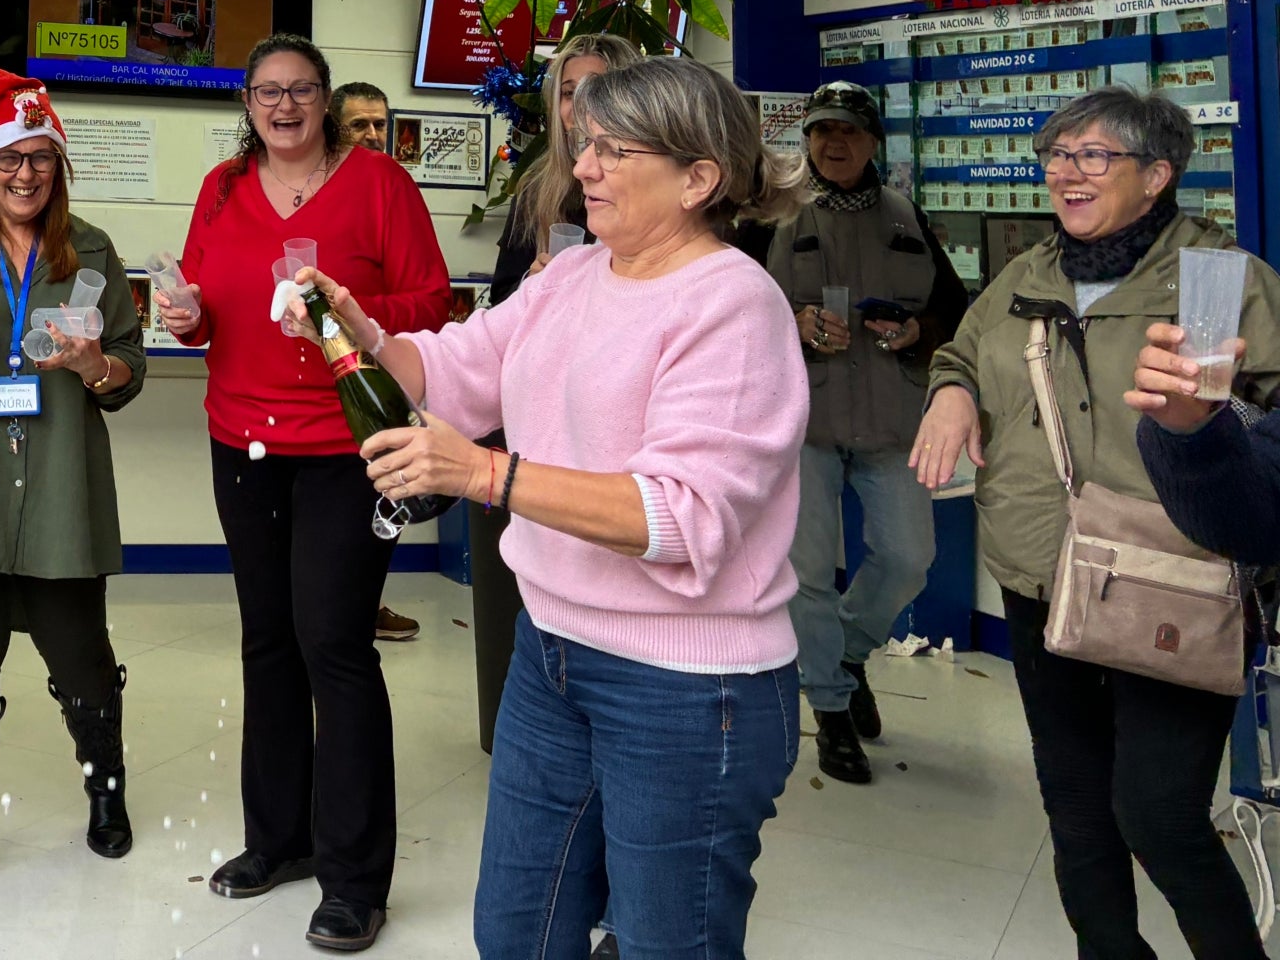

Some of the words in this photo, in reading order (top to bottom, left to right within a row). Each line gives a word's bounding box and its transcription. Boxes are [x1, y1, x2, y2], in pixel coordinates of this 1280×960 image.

[1021, 8, 1051, 21] LOTERIA
[1054, 5, 1095, 18] NACIONAL
[1115, 0, 1155, 13] LOTERIA
[904, 21, 936, 34] LOTERIA
[940, 15, 984, 30] NACIONAL
[48, 31, 120, 50] Nº75105
[826, 31, 848, 43] LOTERIA
[849, 27, 881, 40] NACIONAL
[971, 56, 1012, 70] NAVIDAD
[1014, 54, 1026, 65] 20
[1027, 53, 1035, 64] €
[111, 65, 129, 74] BAR
[132, 66, 149, 75] CAL
[151, 67, 189, 77] MANOLO
[1197, 108, 1207, 119] A
[970, 117, 1011, 129] NAVIDAD
[1012, 117, 1026, 127] 20
[1027, 117, 1034, 127] €
[970, 167, 1011, 177] NAVIDAD
[1013, 166, 1026, 177] 20
[1028, 166, 1035, 176] €
